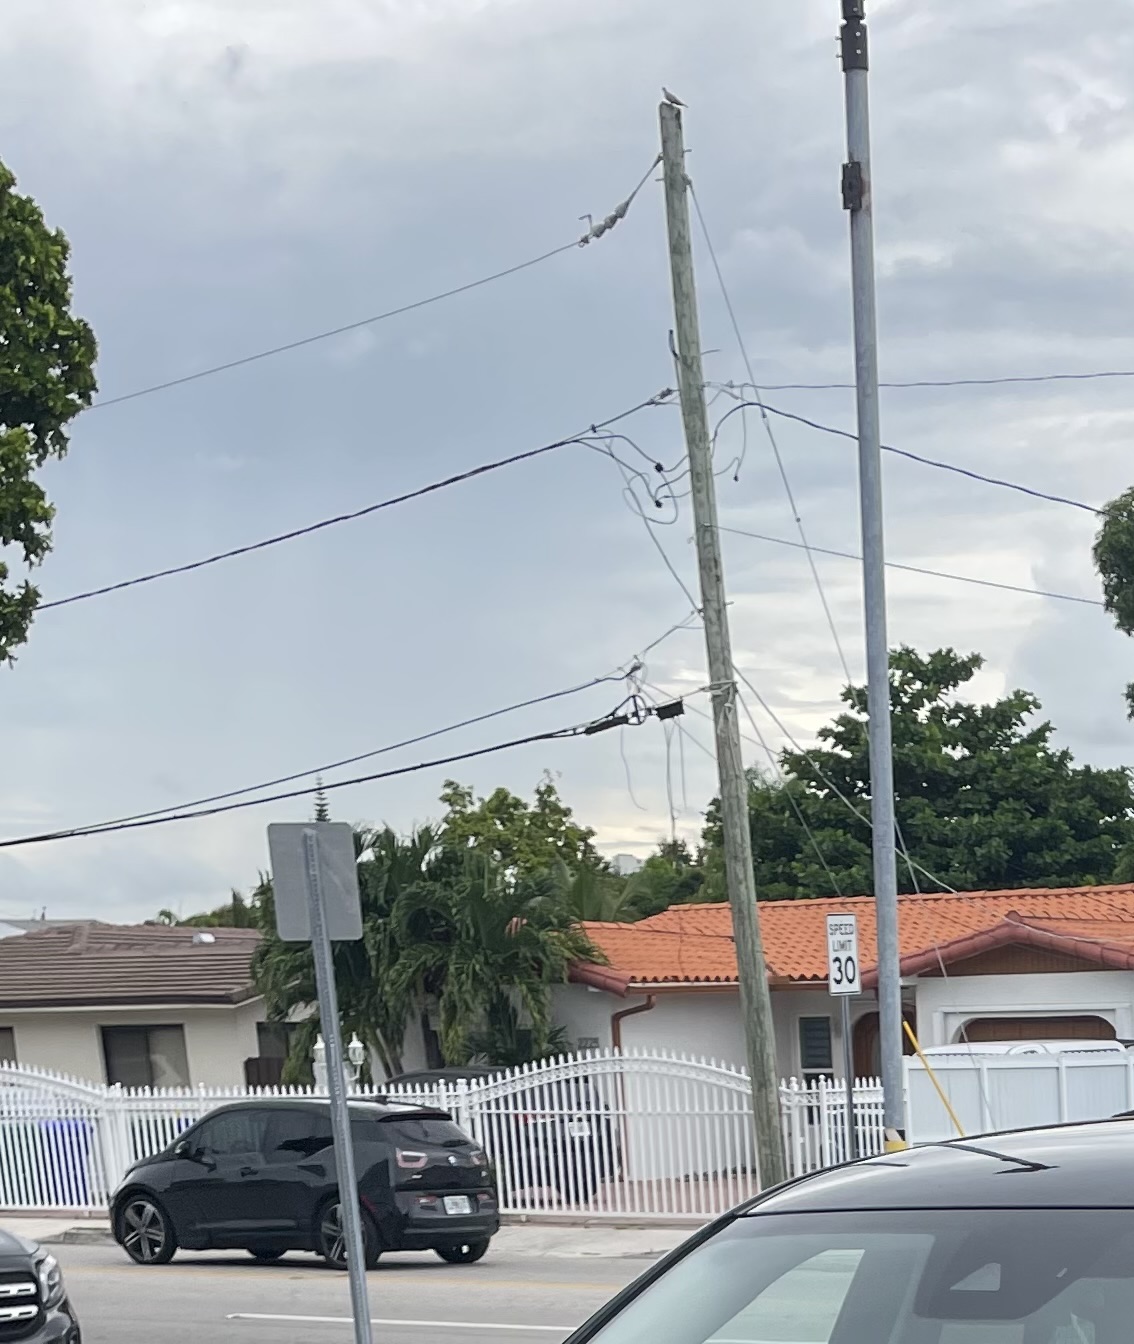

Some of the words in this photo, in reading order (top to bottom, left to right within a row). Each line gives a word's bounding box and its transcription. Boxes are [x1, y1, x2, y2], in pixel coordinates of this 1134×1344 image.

[829, 923, 854, 935] SPEED
[833, 940, 853, 952] LIMIT
[832, 956, 856, 984] 30
